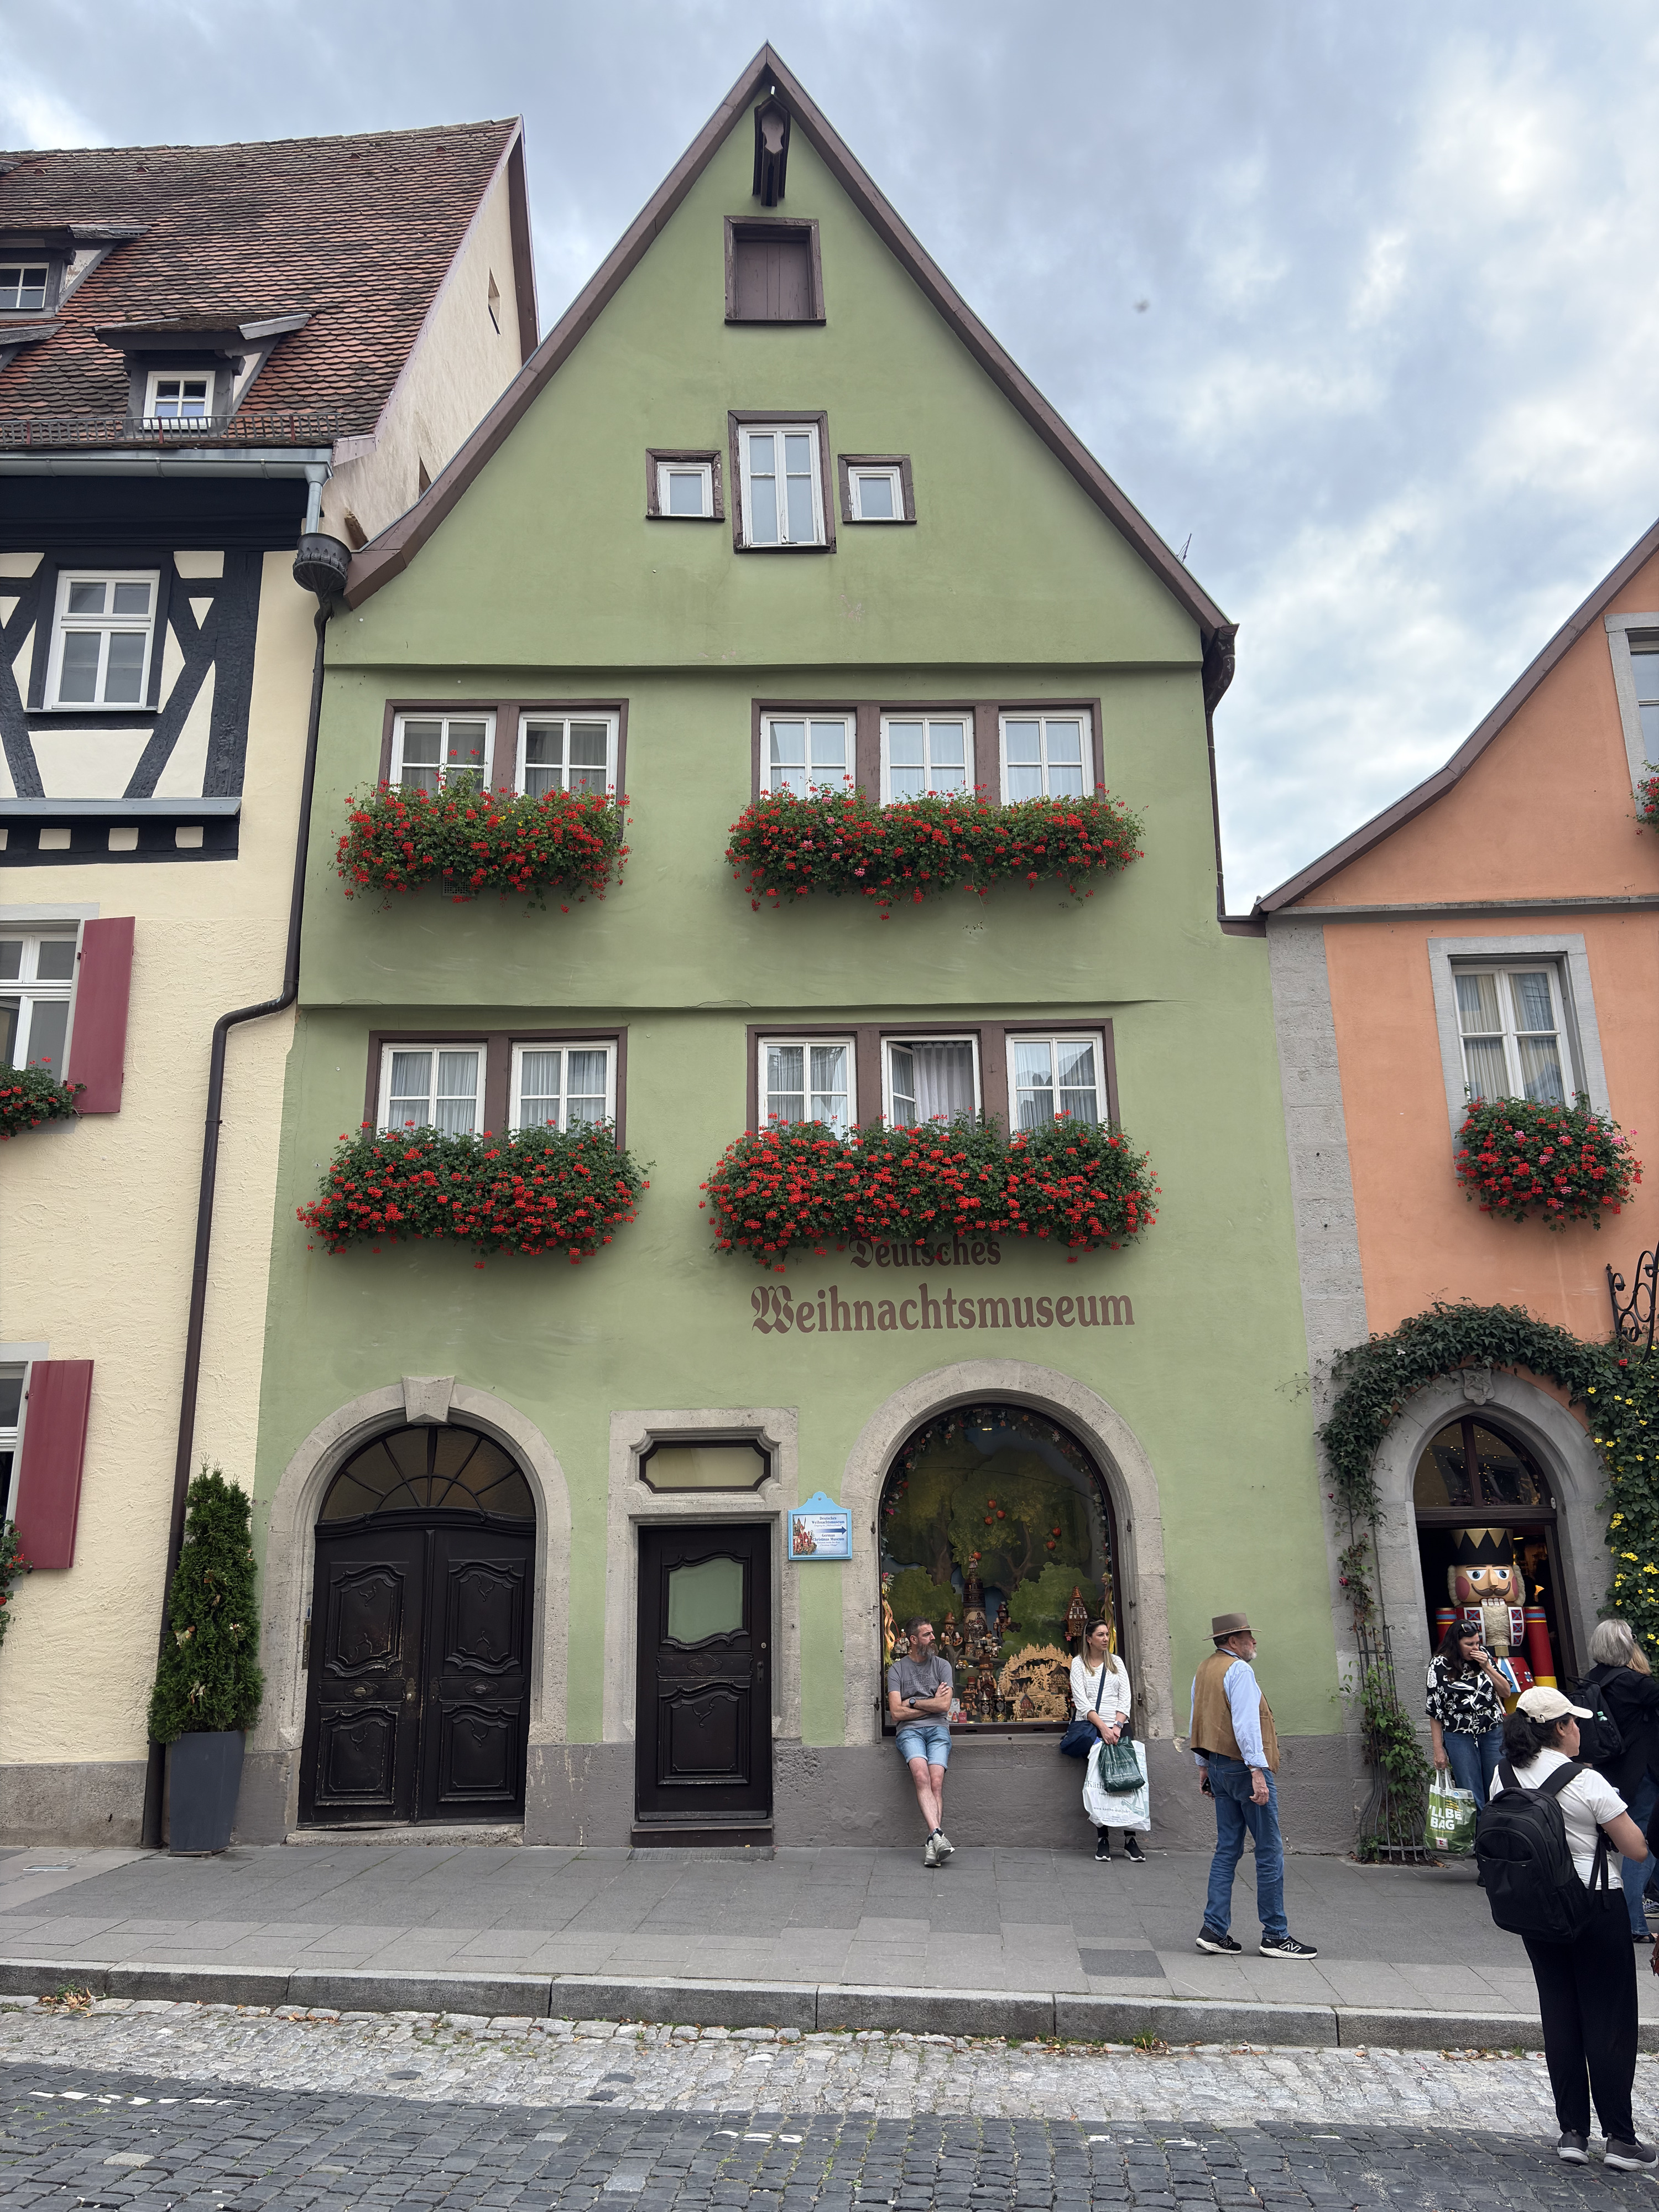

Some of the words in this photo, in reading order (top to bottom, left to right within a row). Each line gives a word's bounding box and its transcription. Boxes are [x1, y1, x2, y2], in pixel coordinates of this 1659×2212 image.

[849, 1234, 1001, 1268] Deutsches
[750, 1282, 1135, 1334] Weihnachtsmuseum
[1087, 1780, 1104, 1790] Käth
[1445, 1808, 1463, 1820] BE
[1430, 1816, 1455, 1830] BAG
